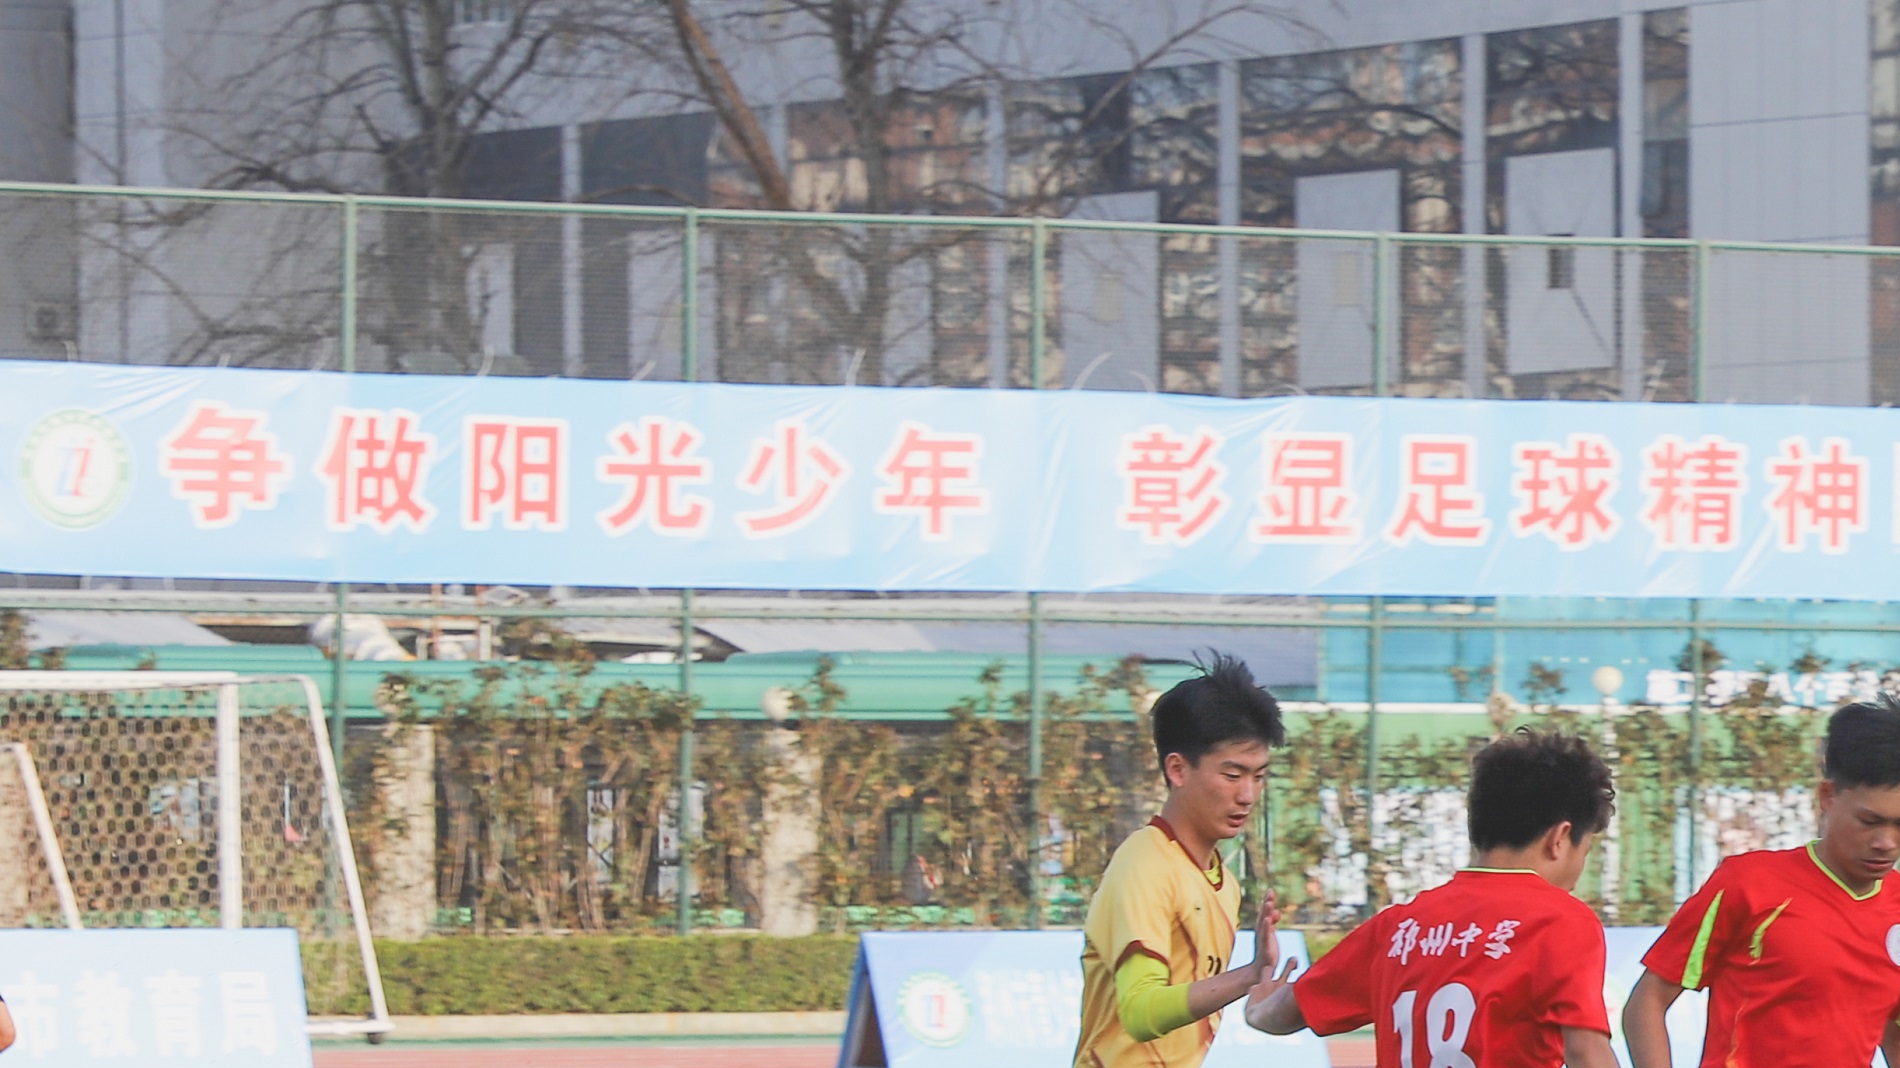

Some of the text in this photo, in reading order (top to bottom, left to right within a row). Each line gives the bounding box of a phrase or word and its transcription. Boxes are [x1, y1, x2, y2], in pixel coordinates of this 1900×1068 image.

[163, 402, 985, 537] 争做阳光少年
[1124, 430, 1864, 550] 彰显足球精神
[2, 968, 279, 1061] 市教育局
